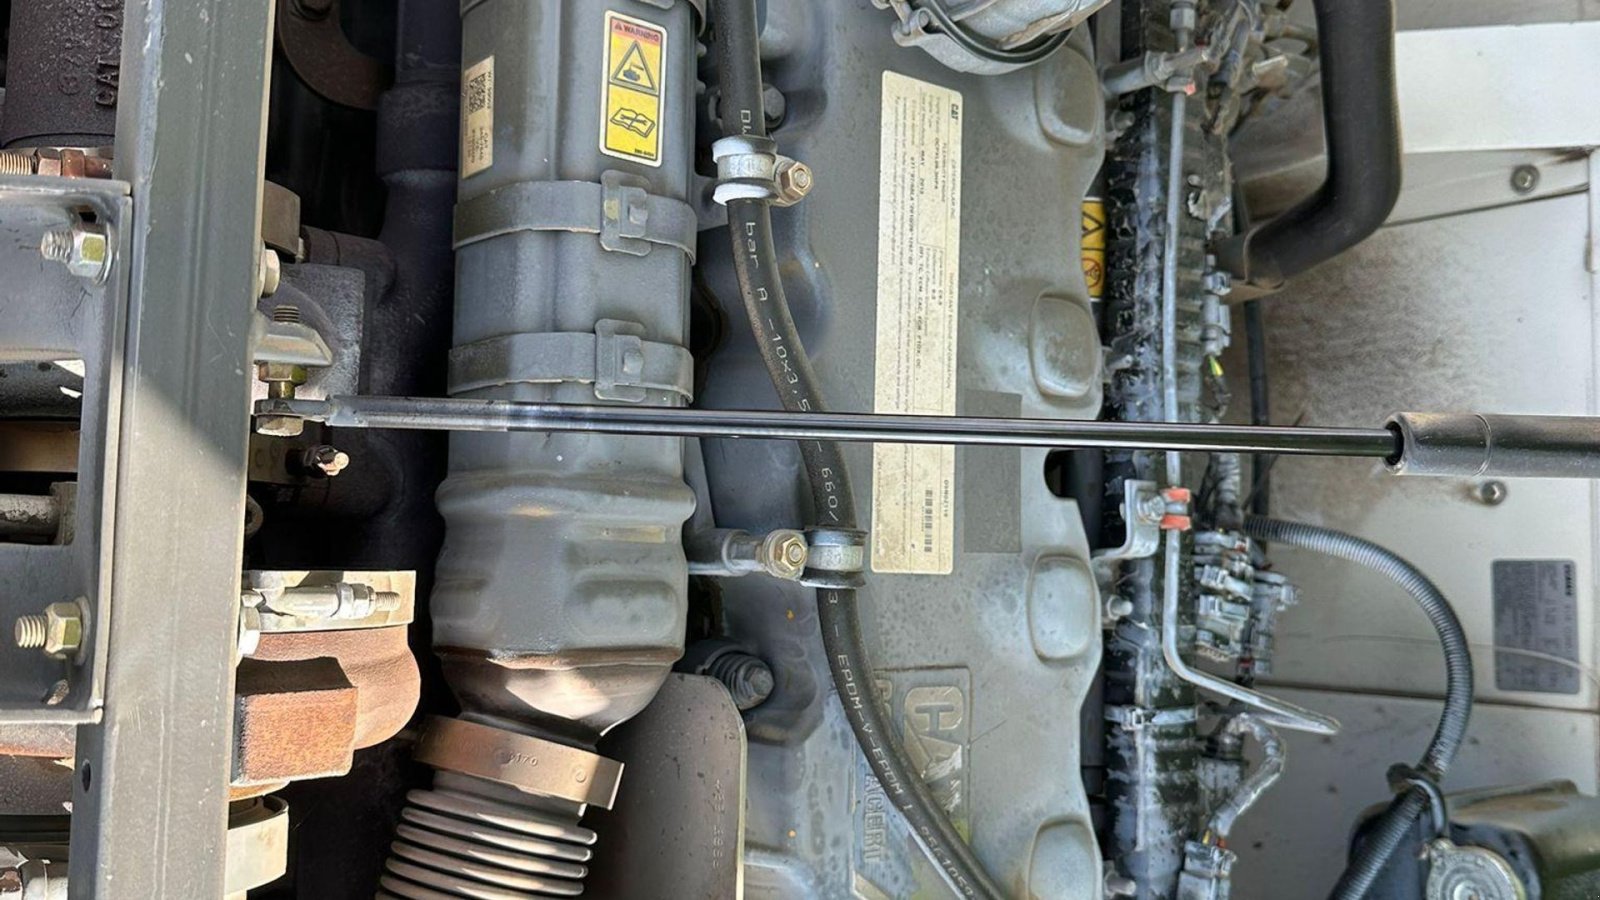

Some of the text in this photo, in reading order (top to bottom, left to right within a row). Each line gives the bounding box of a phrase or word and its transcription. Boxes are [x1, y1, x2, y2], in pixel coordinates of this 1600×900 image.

[624, 25, 659, 42] WARNING
[951, 103, 959, 120] CAT
[745, 222, 759, 269] bar
[757, 288, 768, 301] A
[864, 773, 887, 865] ACERT
